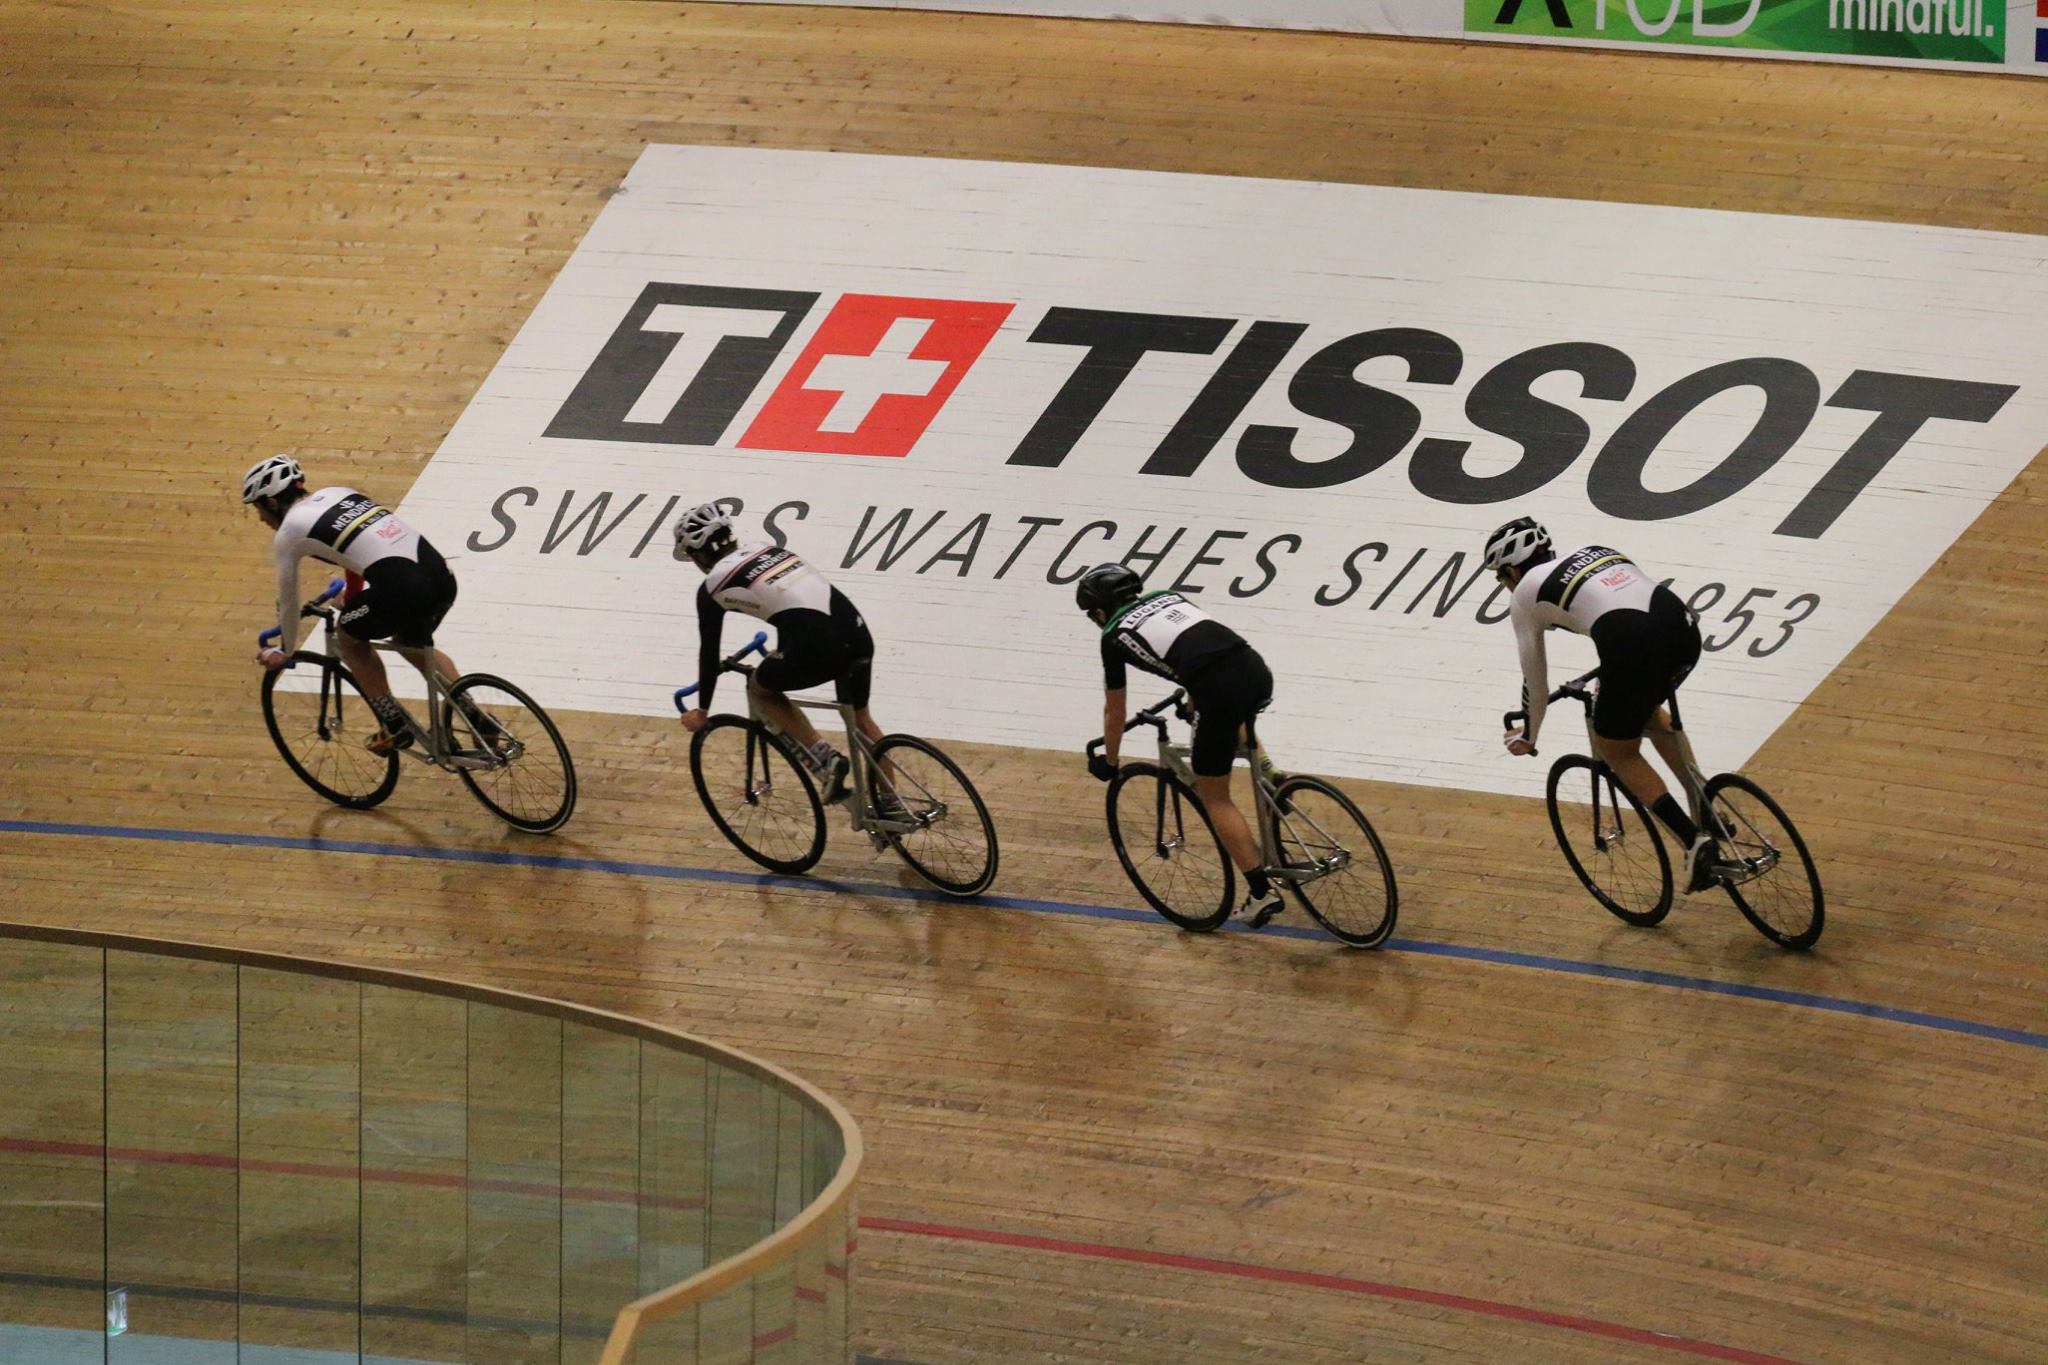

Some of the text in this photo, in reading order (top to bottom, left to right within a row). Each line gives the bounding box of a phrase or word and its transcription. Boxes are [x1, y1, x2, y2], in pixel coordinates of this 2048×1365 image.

[1006, 306, 2020, 537] TISSOT
[841, 506, 1302, 598] WATCHES
[1314, 543, 1516, 625] SIN
[1660, 577, 1820, 657] 853
